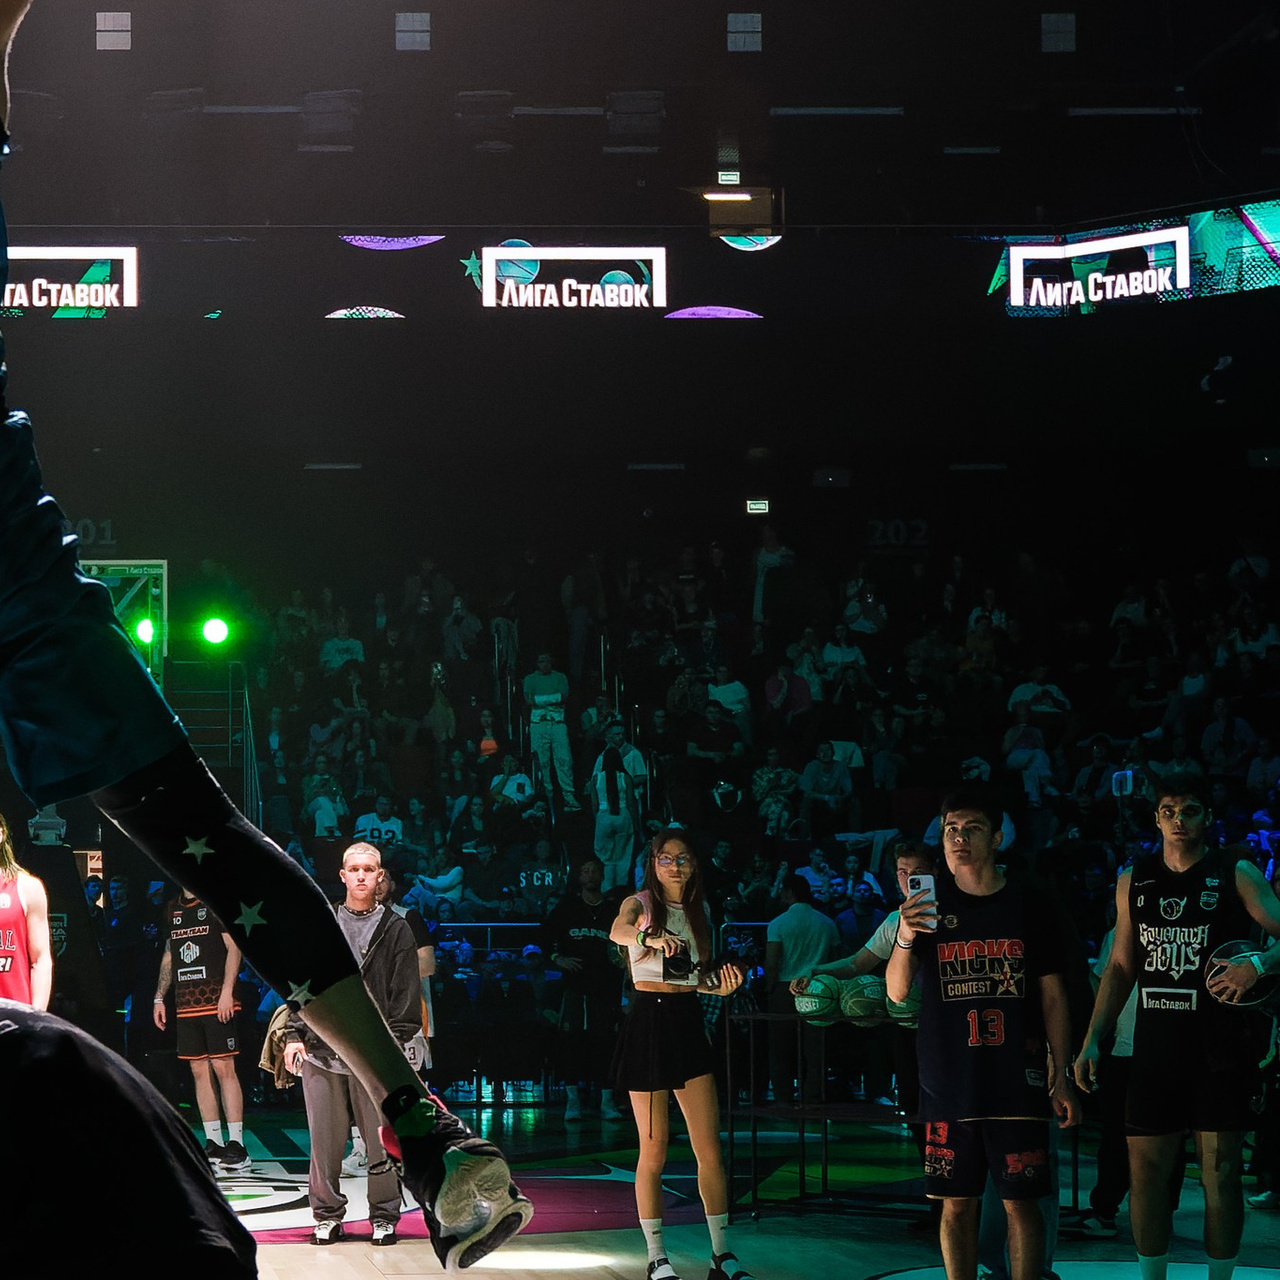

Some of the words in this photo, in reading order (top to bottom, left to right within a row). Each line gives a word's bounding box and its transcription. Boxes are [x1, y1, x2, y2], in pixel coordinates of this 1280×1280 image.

[936, 938, 1026, 980] KICKS
[947, 981, 992, 997] CONTEST
[966, 1008, 1005, 1047] 13
